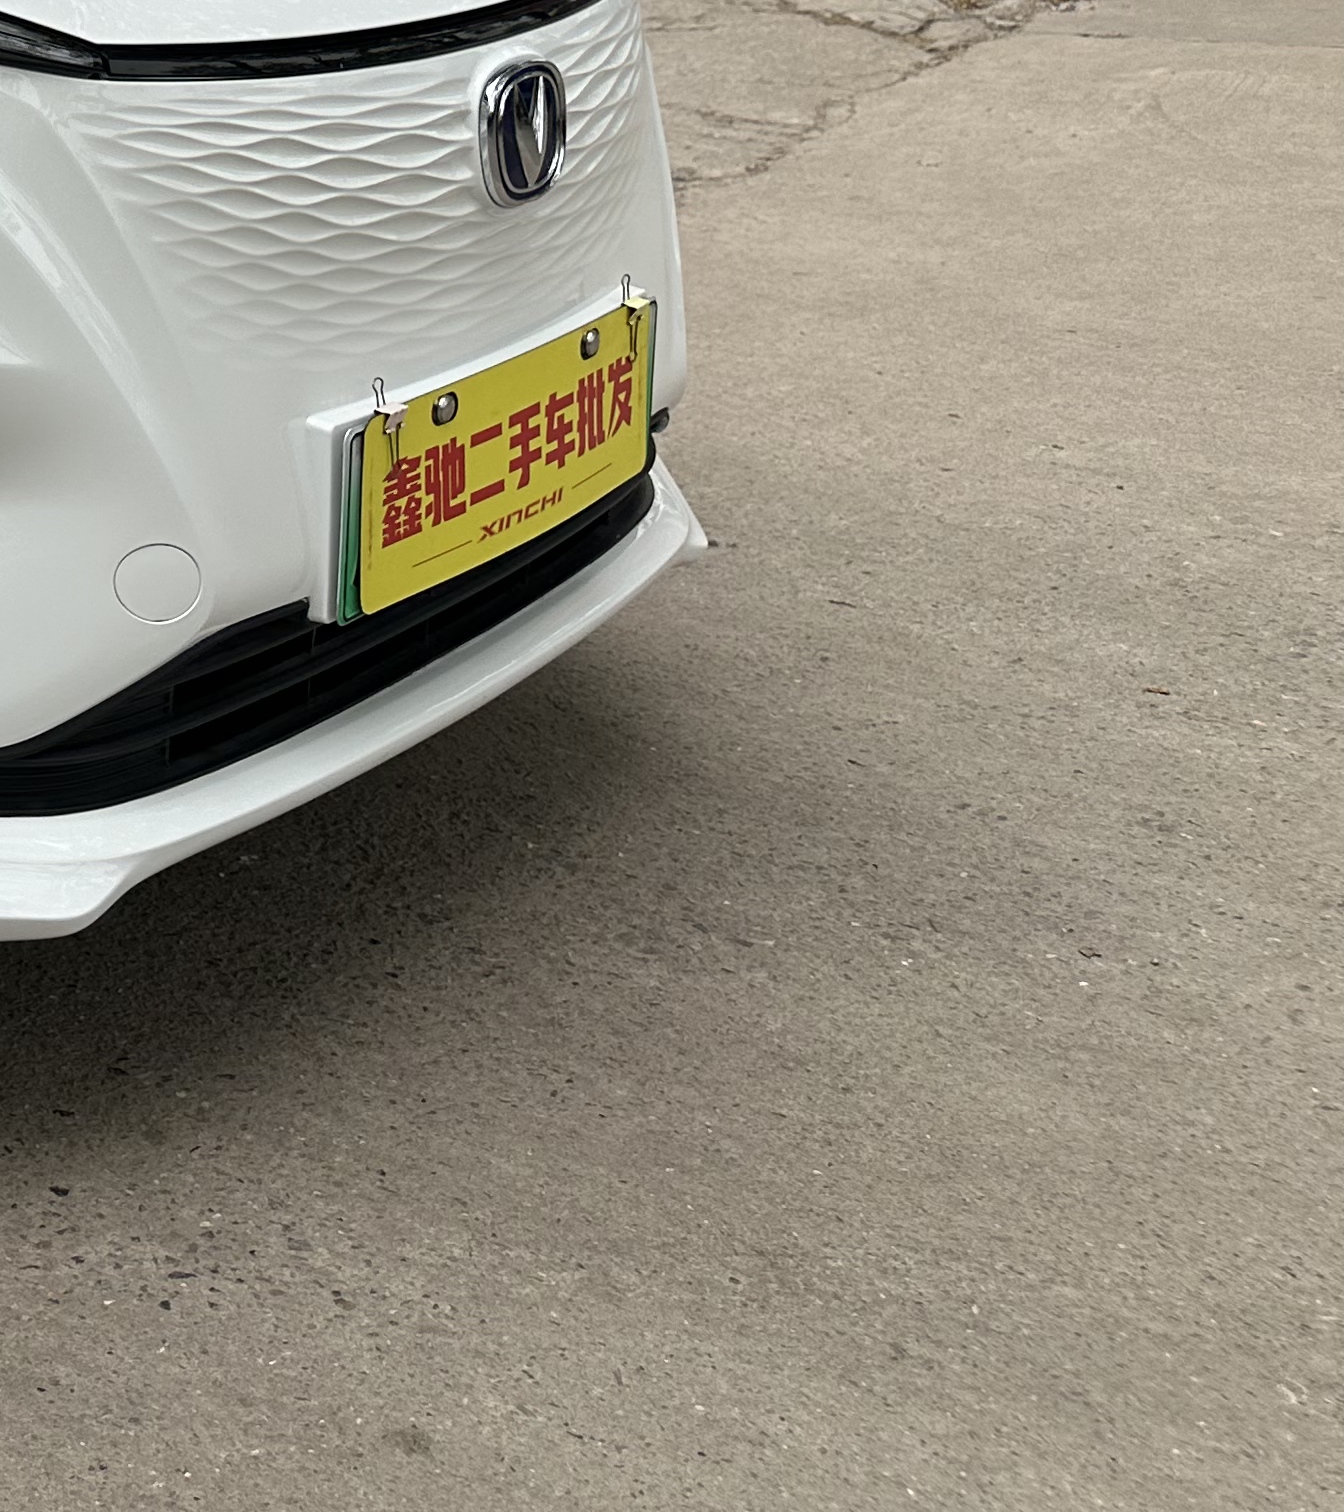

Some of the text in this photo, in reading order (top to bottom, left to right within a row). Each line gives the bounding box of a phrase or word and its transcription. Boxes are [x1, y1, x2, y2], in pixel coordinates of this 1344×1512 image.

[382, 355, 634, 549] 鑫驰二手车批发
[477, 486, 565, 545] XINCHI
